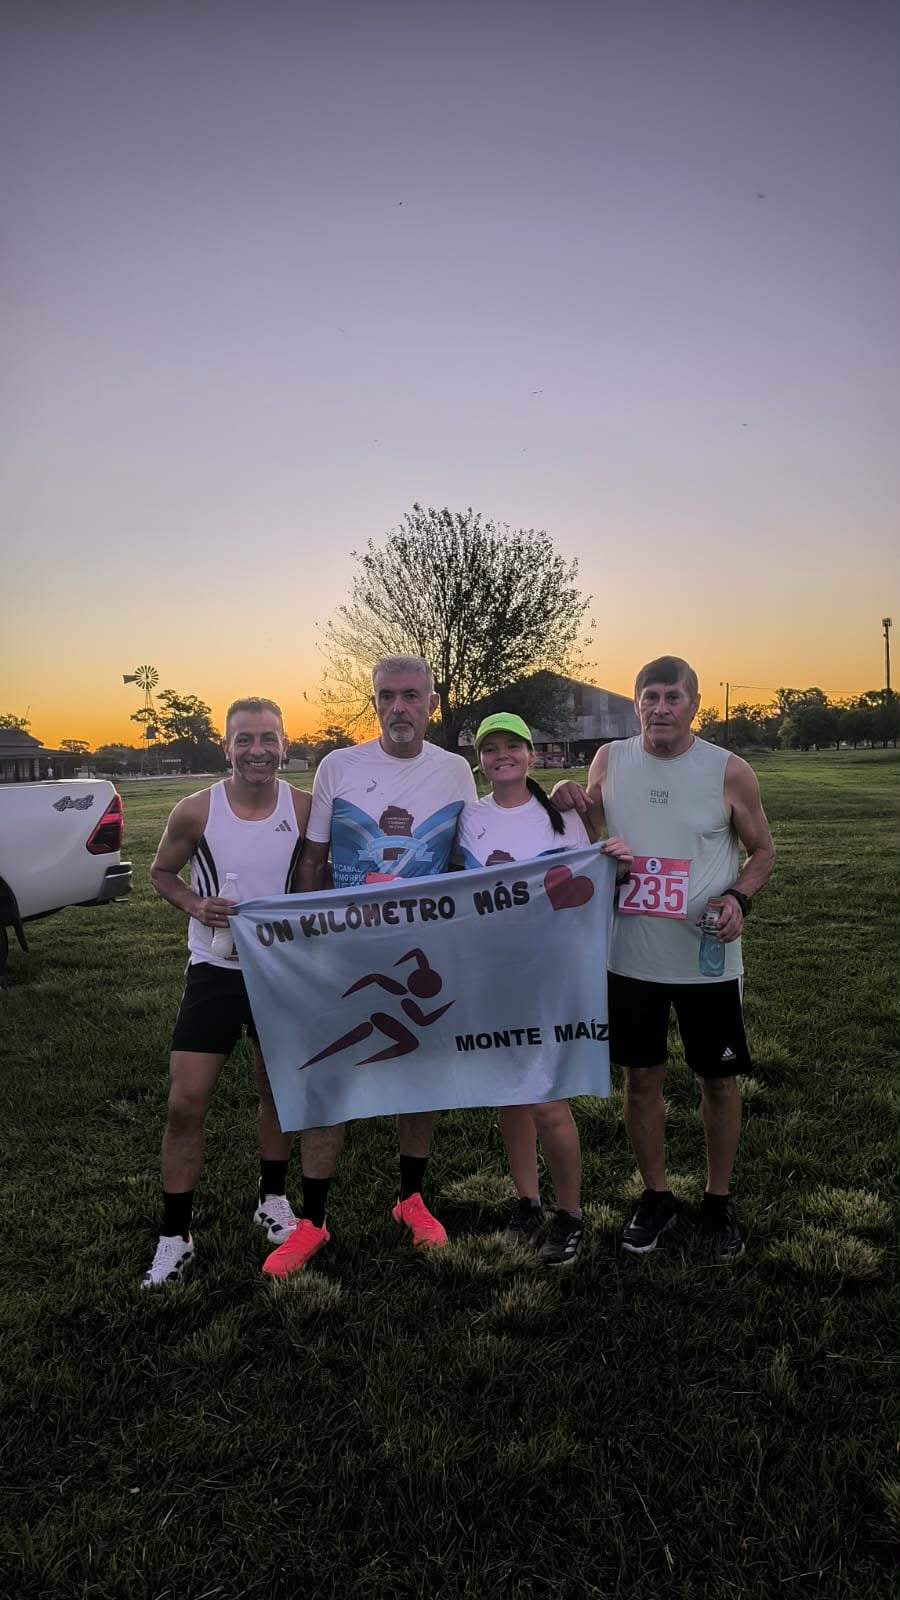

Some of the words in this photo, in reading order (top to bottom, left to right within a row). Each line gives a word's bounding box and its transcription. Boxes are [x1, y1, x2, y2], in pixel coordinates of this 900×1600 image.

[623, 874, 684, 912] 235
[256, 918, 294, 947] UN
[300, 896, 456, 938] KILÓMETRO
[473, 881, 530, 916] MÁS
[455, 1027, 542, 1052] MONTE
[554, 1018, 609, 1043] MAÍZ
